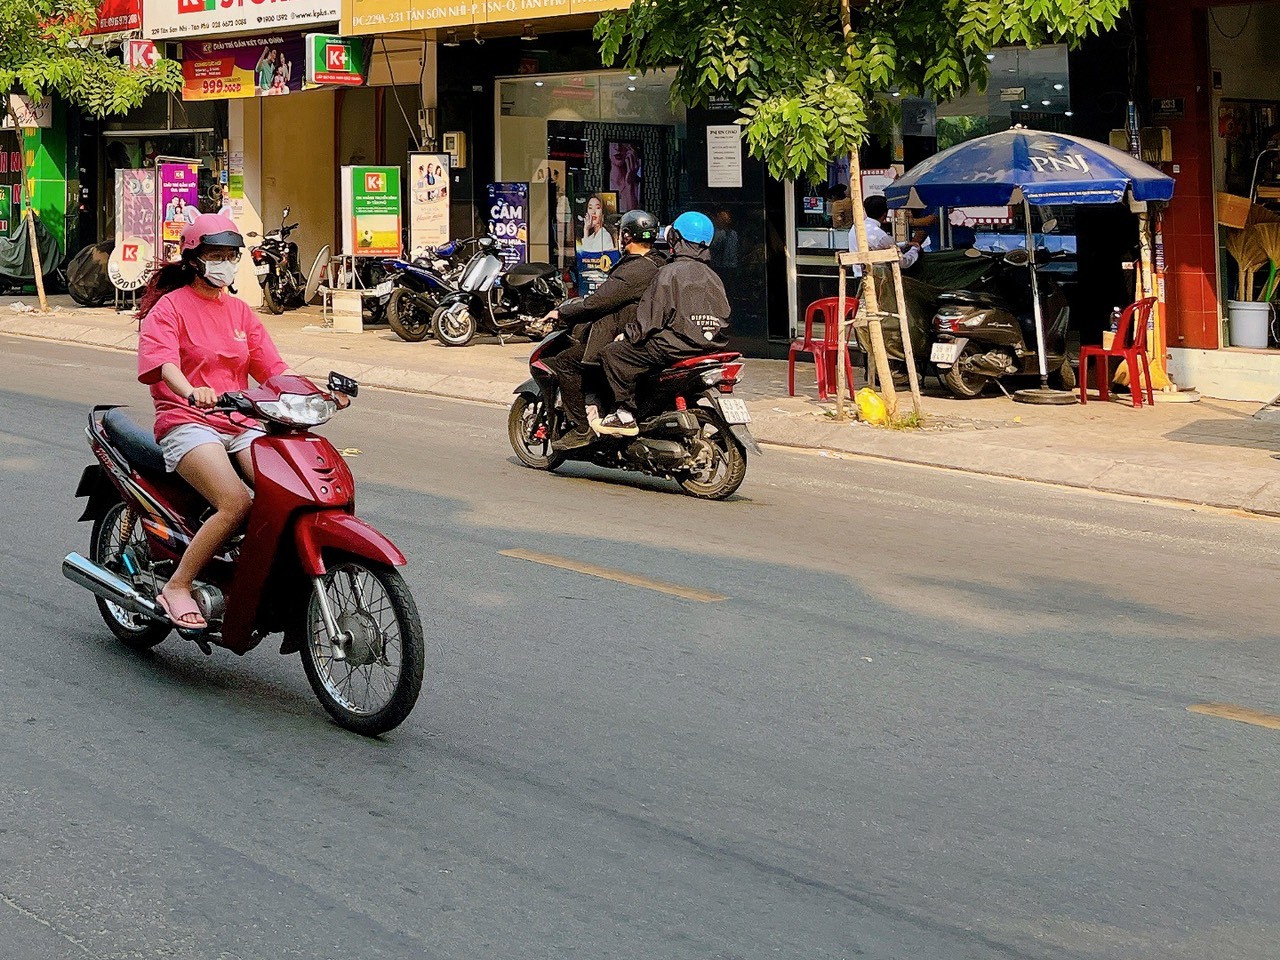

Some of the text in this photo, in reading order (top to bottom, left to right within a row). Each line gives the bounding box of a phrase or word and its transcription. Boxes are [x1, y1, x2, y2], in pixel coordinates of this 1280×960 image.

[426, 4, 447, 19] SƠN
[330, 50, 348, 66] K+
[1028, 153, 1091, 174] PNJ
[490, 202, 523, 219] CẦM
